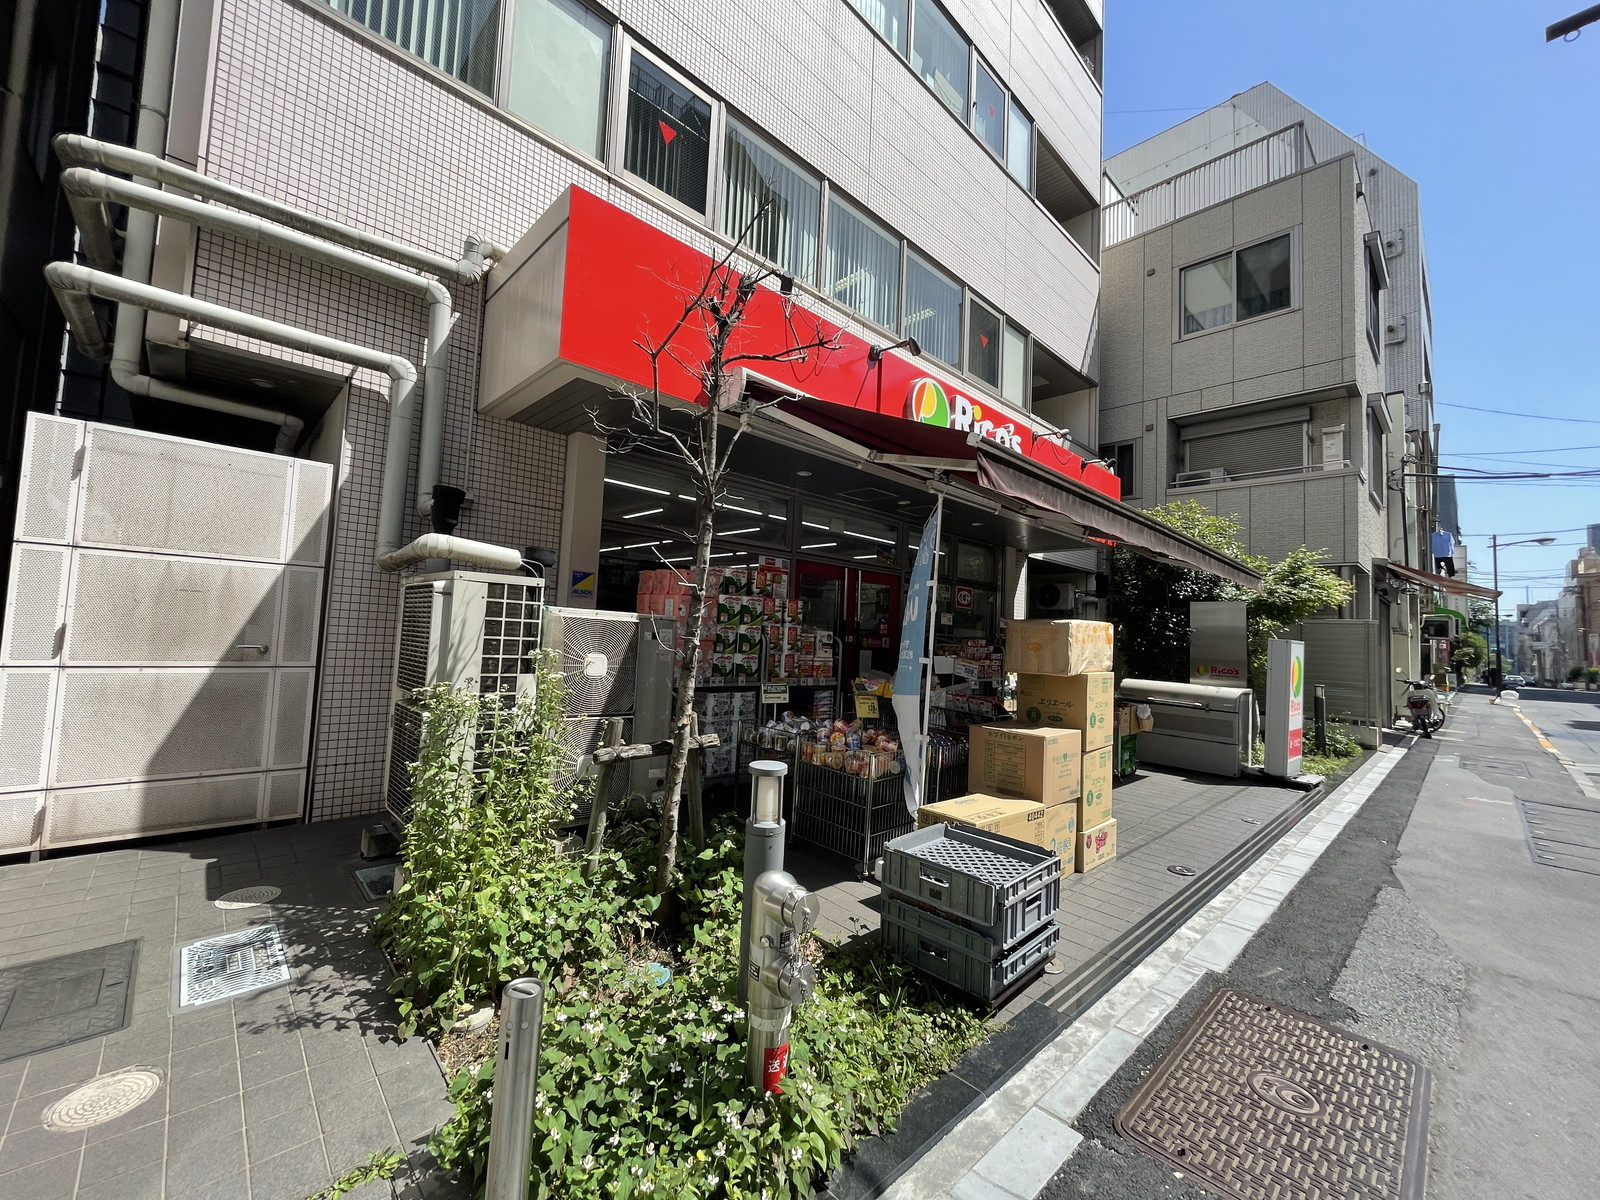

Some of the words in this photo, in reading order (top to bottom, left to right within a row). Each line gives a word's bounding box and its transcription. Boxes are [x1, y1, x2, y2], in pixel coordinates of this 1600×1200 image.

[953, 394, 1022, 454] Rico's
[1210, 666, 1240, 675] Rico's
[1039, 699, 1074, 708] エリエール
[1028, 811, 1044, 821] 40442
